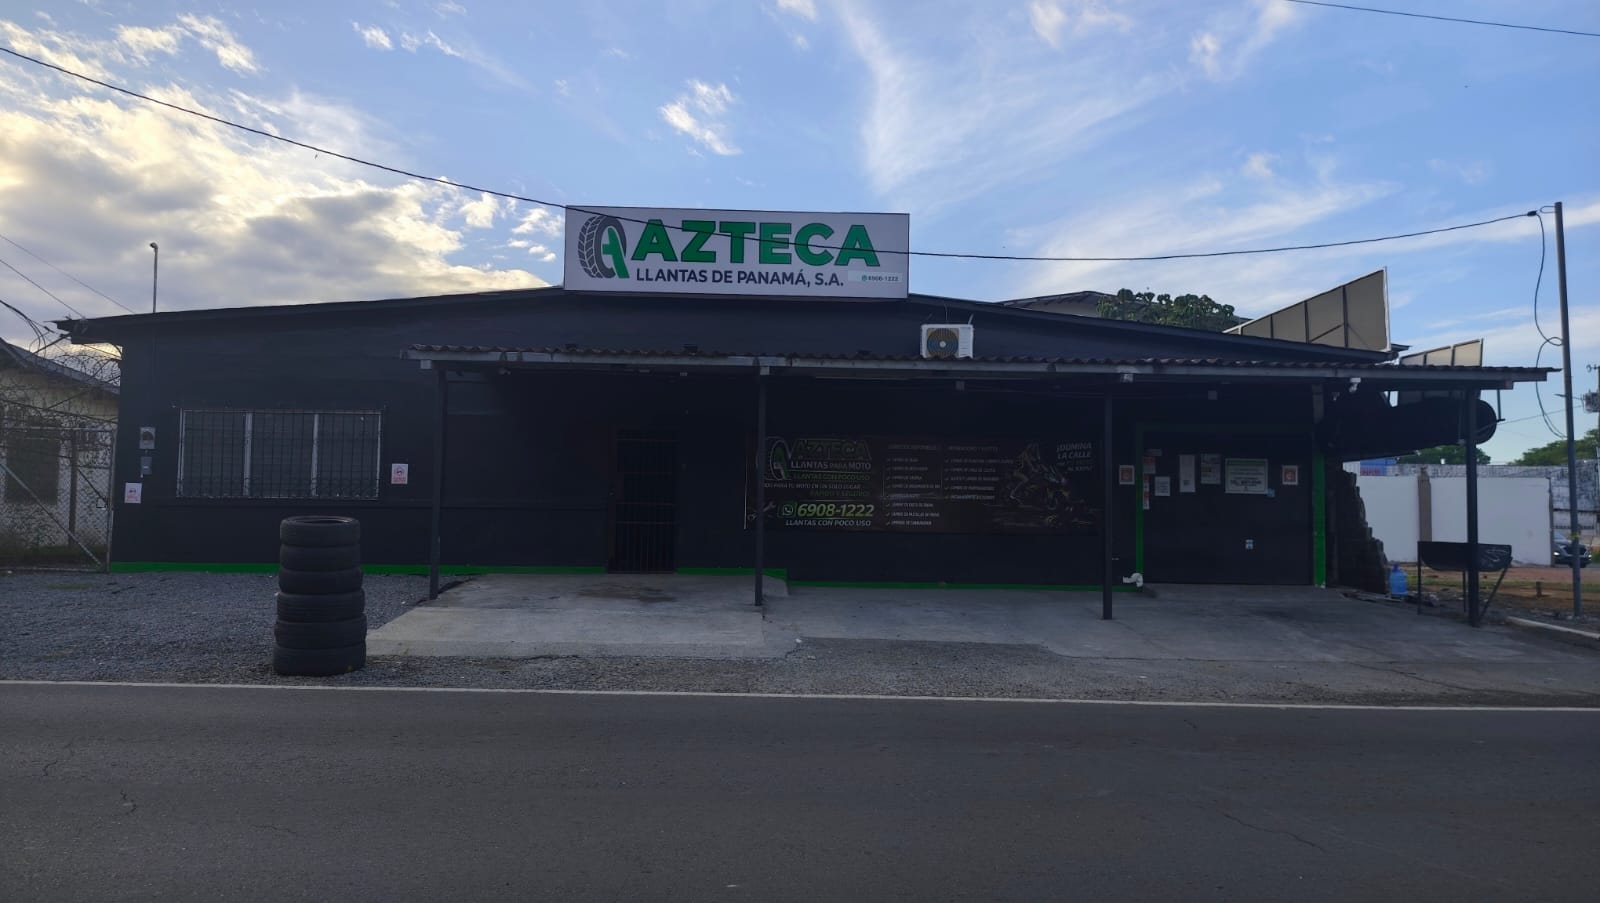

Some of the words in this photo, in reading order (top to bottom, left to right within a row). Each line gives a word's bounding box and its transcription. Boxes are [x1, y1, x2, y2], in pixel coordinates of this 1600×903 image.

[630, 218, 881, 267] AZTECA
[636, 268, 707, 283] LLANTAS
[711, 271, 733, 284] DE
[737, 269, 811, 288] PANAMÁ,
[814, 272, 844, 287] S.A.
[791, 460, 829, 470] LLANTAS
[829, 462, 847, 470] PARA
[847, 461, 872, 470] MOTO
[797, 503, 875, 517] 6908-1222
[785, 519, 817, 527] LLANTAS
